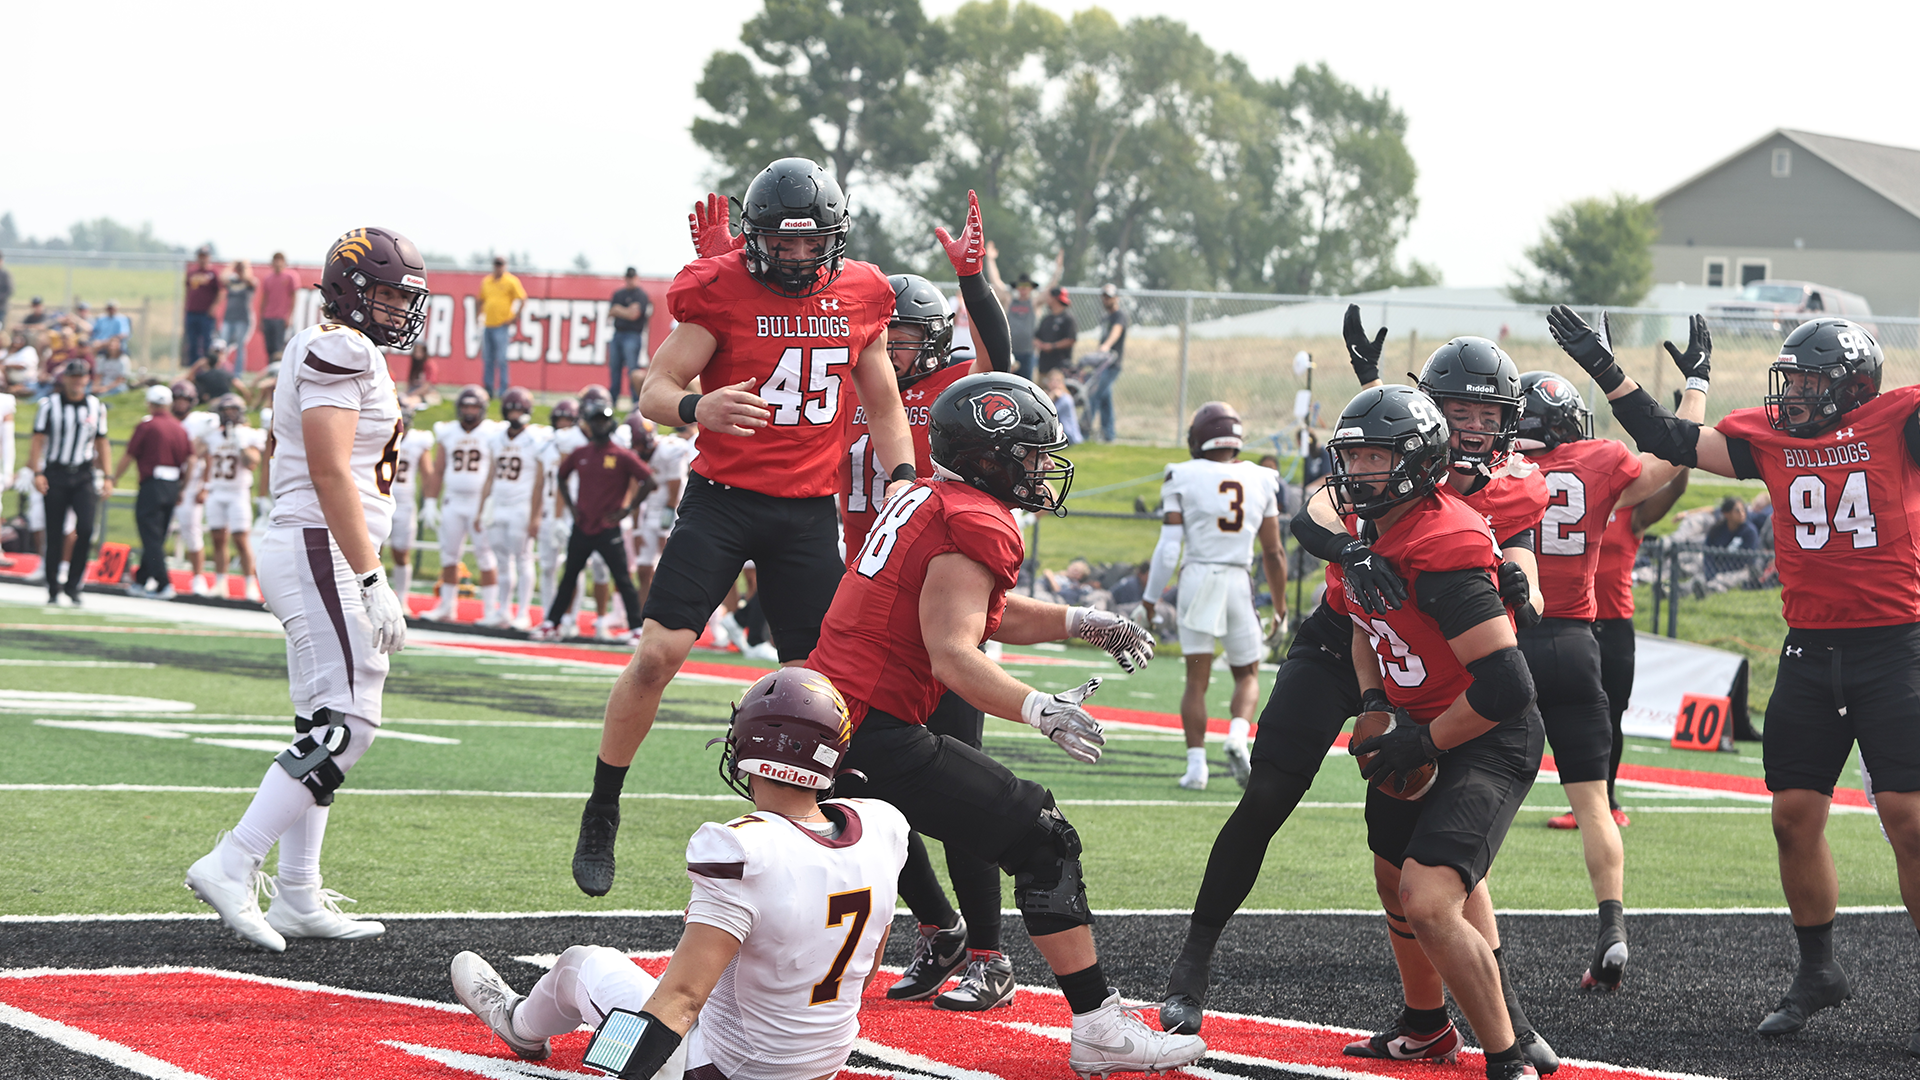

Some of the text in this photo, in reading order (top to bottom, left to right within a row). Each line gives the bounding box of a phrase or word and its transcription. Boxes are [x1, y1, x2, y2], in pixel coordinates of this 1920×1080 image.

[756, 315, 850, 338] BULLDOGS
[1836, 330, 1870, 360] 94
[759, 346, 850, 426] 45
[1466, 384, 1495, 394] Riddell
[1407, 399, 1440, 434] 93
[1462, 454, 1482, 462] Riddell
[1783, 441, 1871, 468] BULLDOGS
[1217, 480, 1245, 533] 3
[1530, 471, 1587, 556] 2
[1788, 470, 1878, 550] 94
[1675, 701, 1720, 745] 10
[759, 763, 819, 787] Riddell
[727, 814, 768, 830] 7
[808, 886, 872, 1007] 7
